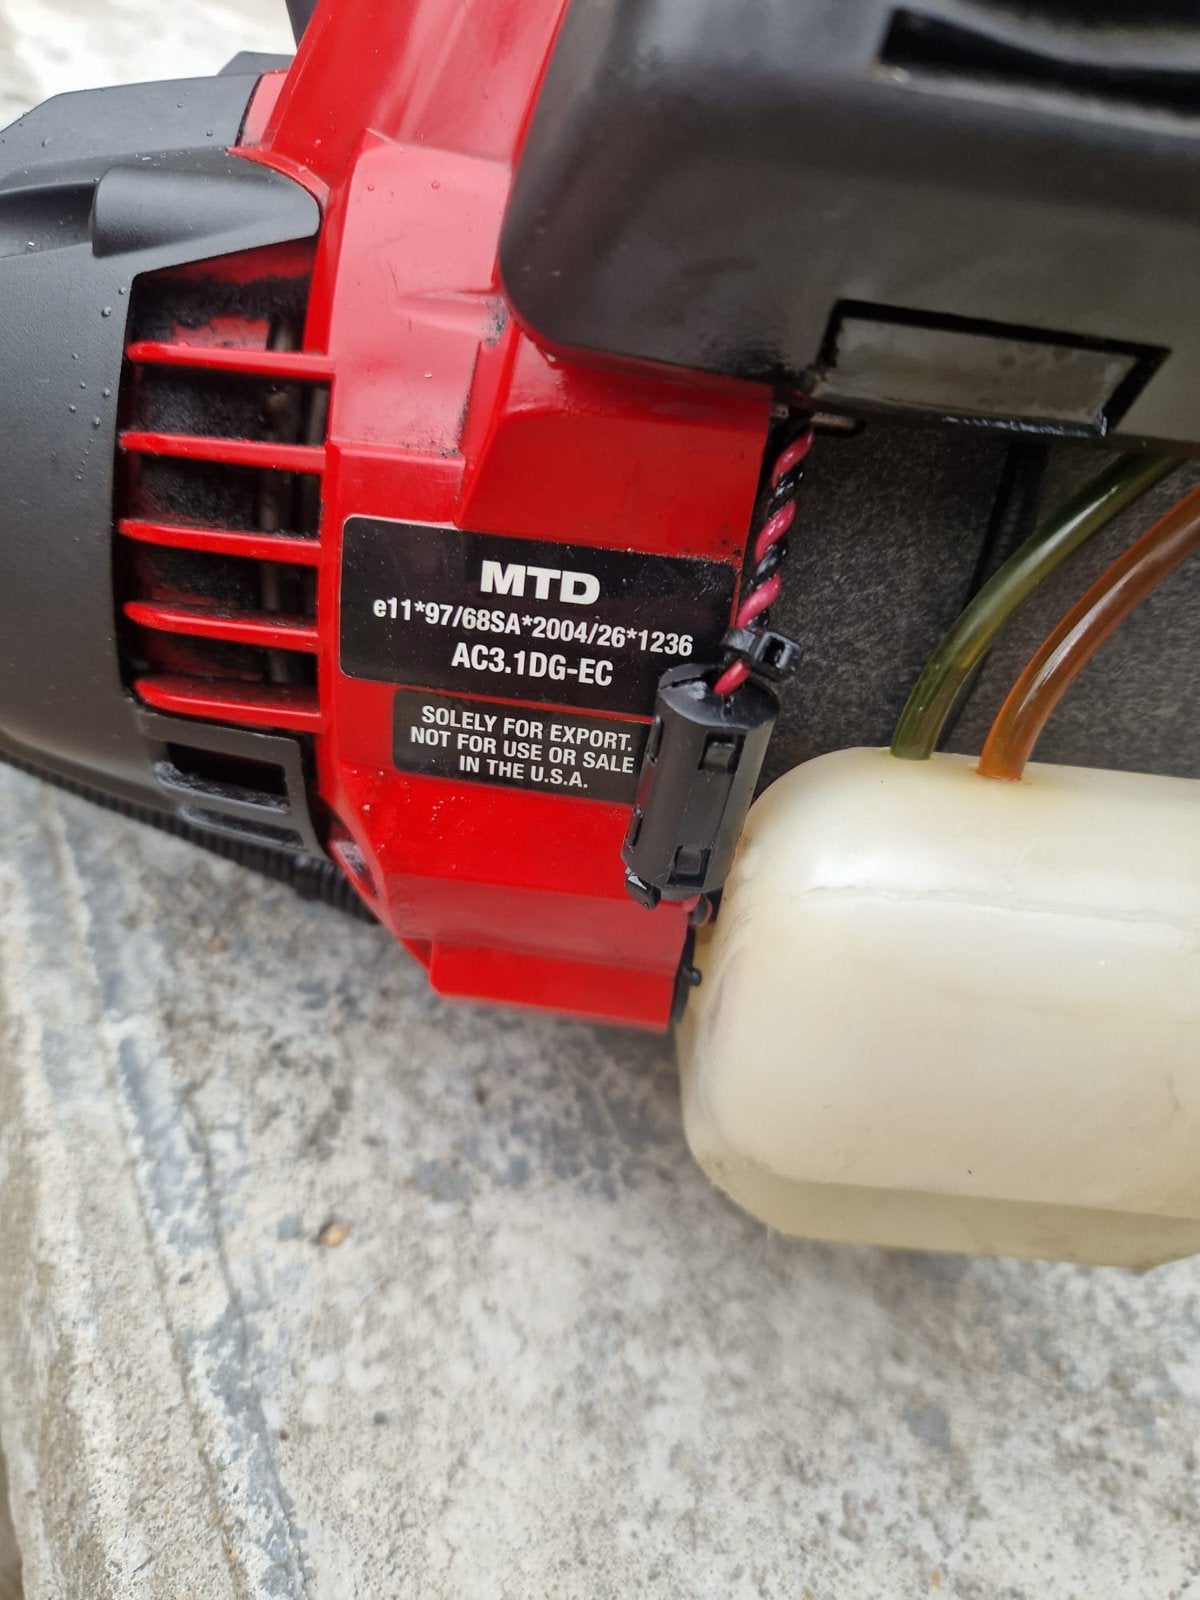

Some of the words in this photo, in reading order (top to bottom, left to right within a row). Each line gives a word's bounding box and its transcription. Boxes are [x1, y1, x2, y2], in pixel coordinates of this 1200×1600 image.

[480, 559, 600, 605] MTD
[451, 642, 613, 687] AC3.1DG-EC
[410, 726, 452, 749] NOT
[457, 733, 497, 755] FOR
[503, 739, 542, 761] USE
[548, 745, 577, 766] OR
[582, 752, 635, 774] SALE
[421, 705, 497, 732] SOLELY
[503, 717, 543, 739] FOR
[550, 723, 632, 752] EXPORT.
[459, 754, 480, 773] IN
[486, 759, 524, 780] THE
[530, 764, 588, 789] U.S.A.
